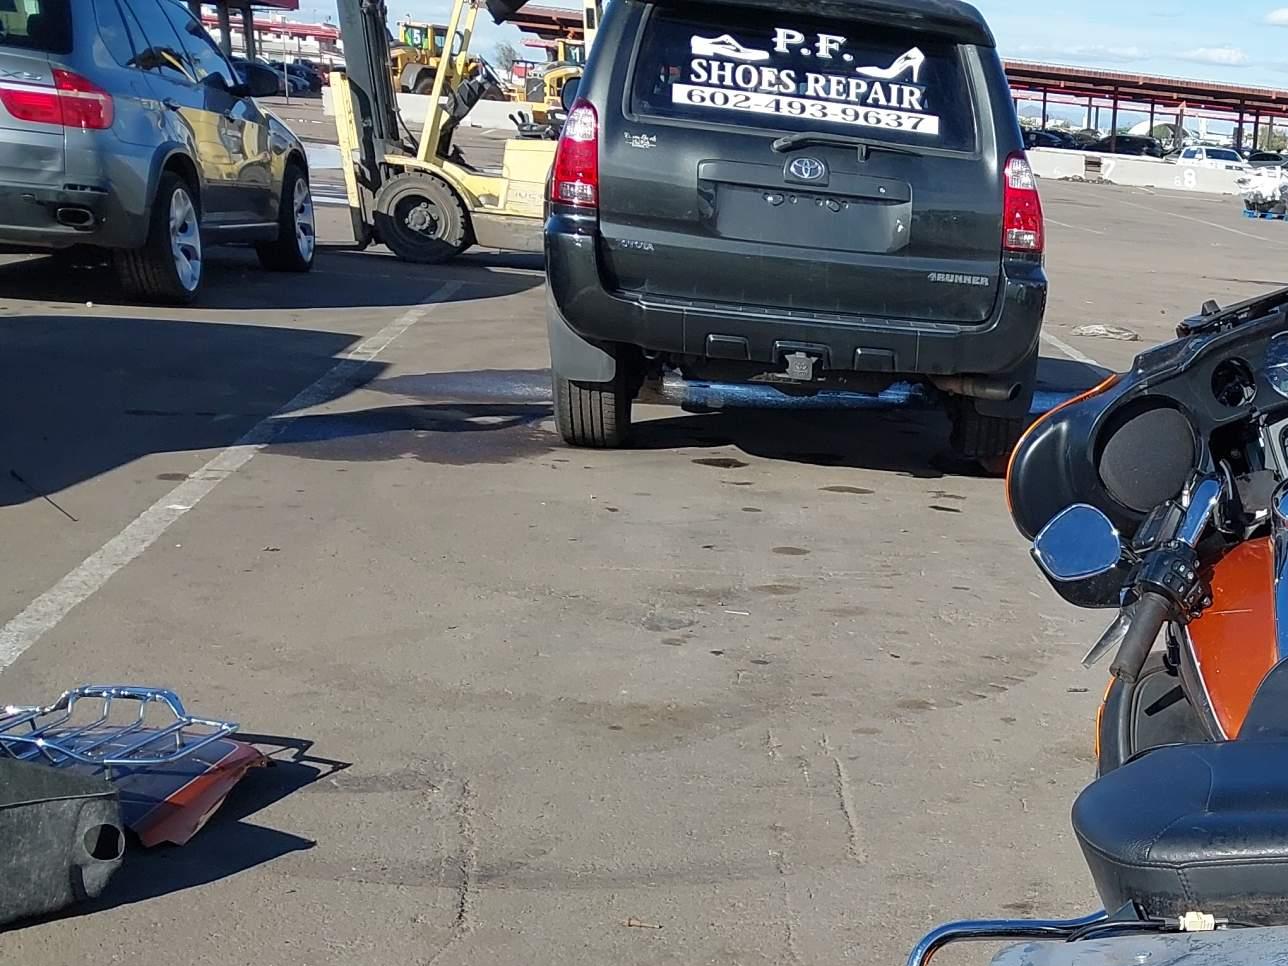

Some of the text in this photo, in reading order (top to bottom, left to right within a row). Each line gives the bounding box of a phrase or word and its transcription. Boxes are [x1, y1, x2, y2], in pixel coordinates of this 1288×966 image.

[771, 27, 854, 62] P.F.
[690, 58, 923, 111] SHOES REPAIR
[686, 88, 926, 131] 602-493-9637
[927, 272, 990, 287] 4RUNNER
